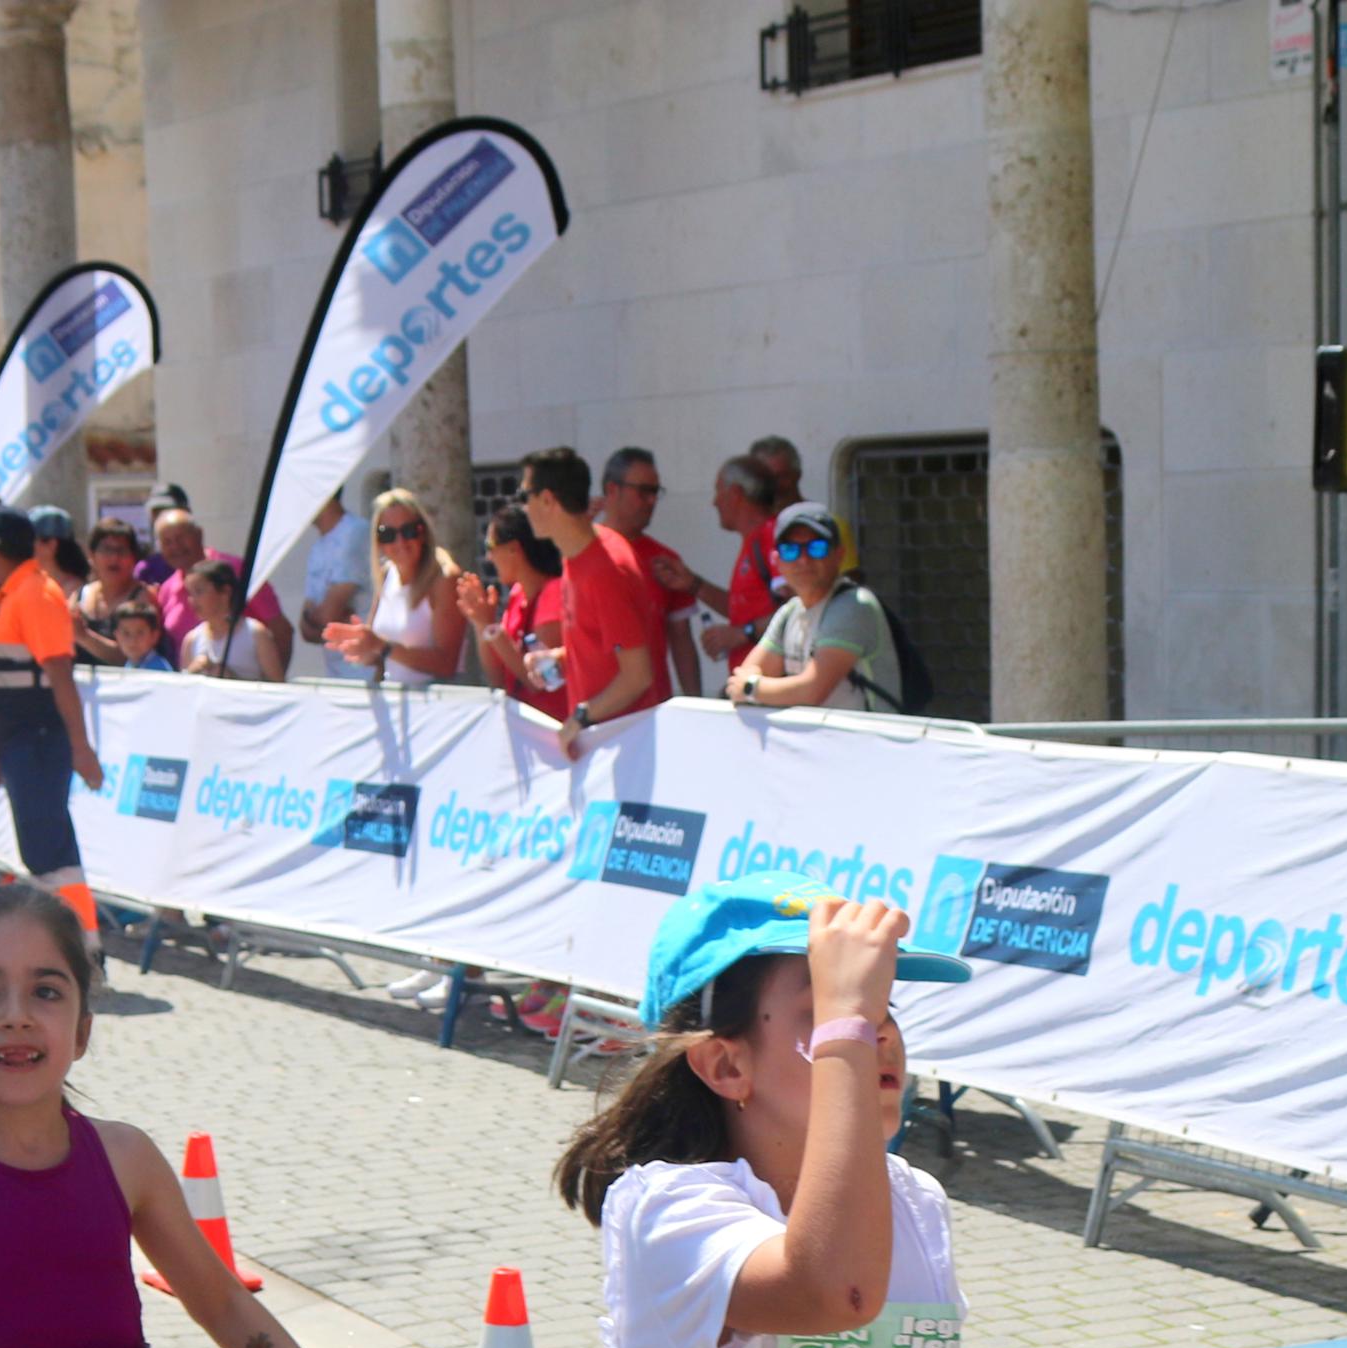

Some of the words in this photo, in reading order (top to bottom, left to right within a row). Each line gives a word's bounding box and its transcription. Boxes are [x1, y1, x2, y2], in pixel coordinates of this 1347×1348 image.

[319, 211, 533, 433] deportes
[196, 763, 317, 832] deportes
[429, 790, 572, 867] deportes
[615, 814, 684, 848] Diputación
[606, 847, 628, 872] DE
[628, 849, 691, 882] PALENCIA
[981, 876, 1077, 917] Diputación
[970, 915, 994, 944] DE
[998, 919, 1088, 959] PALENCIA
